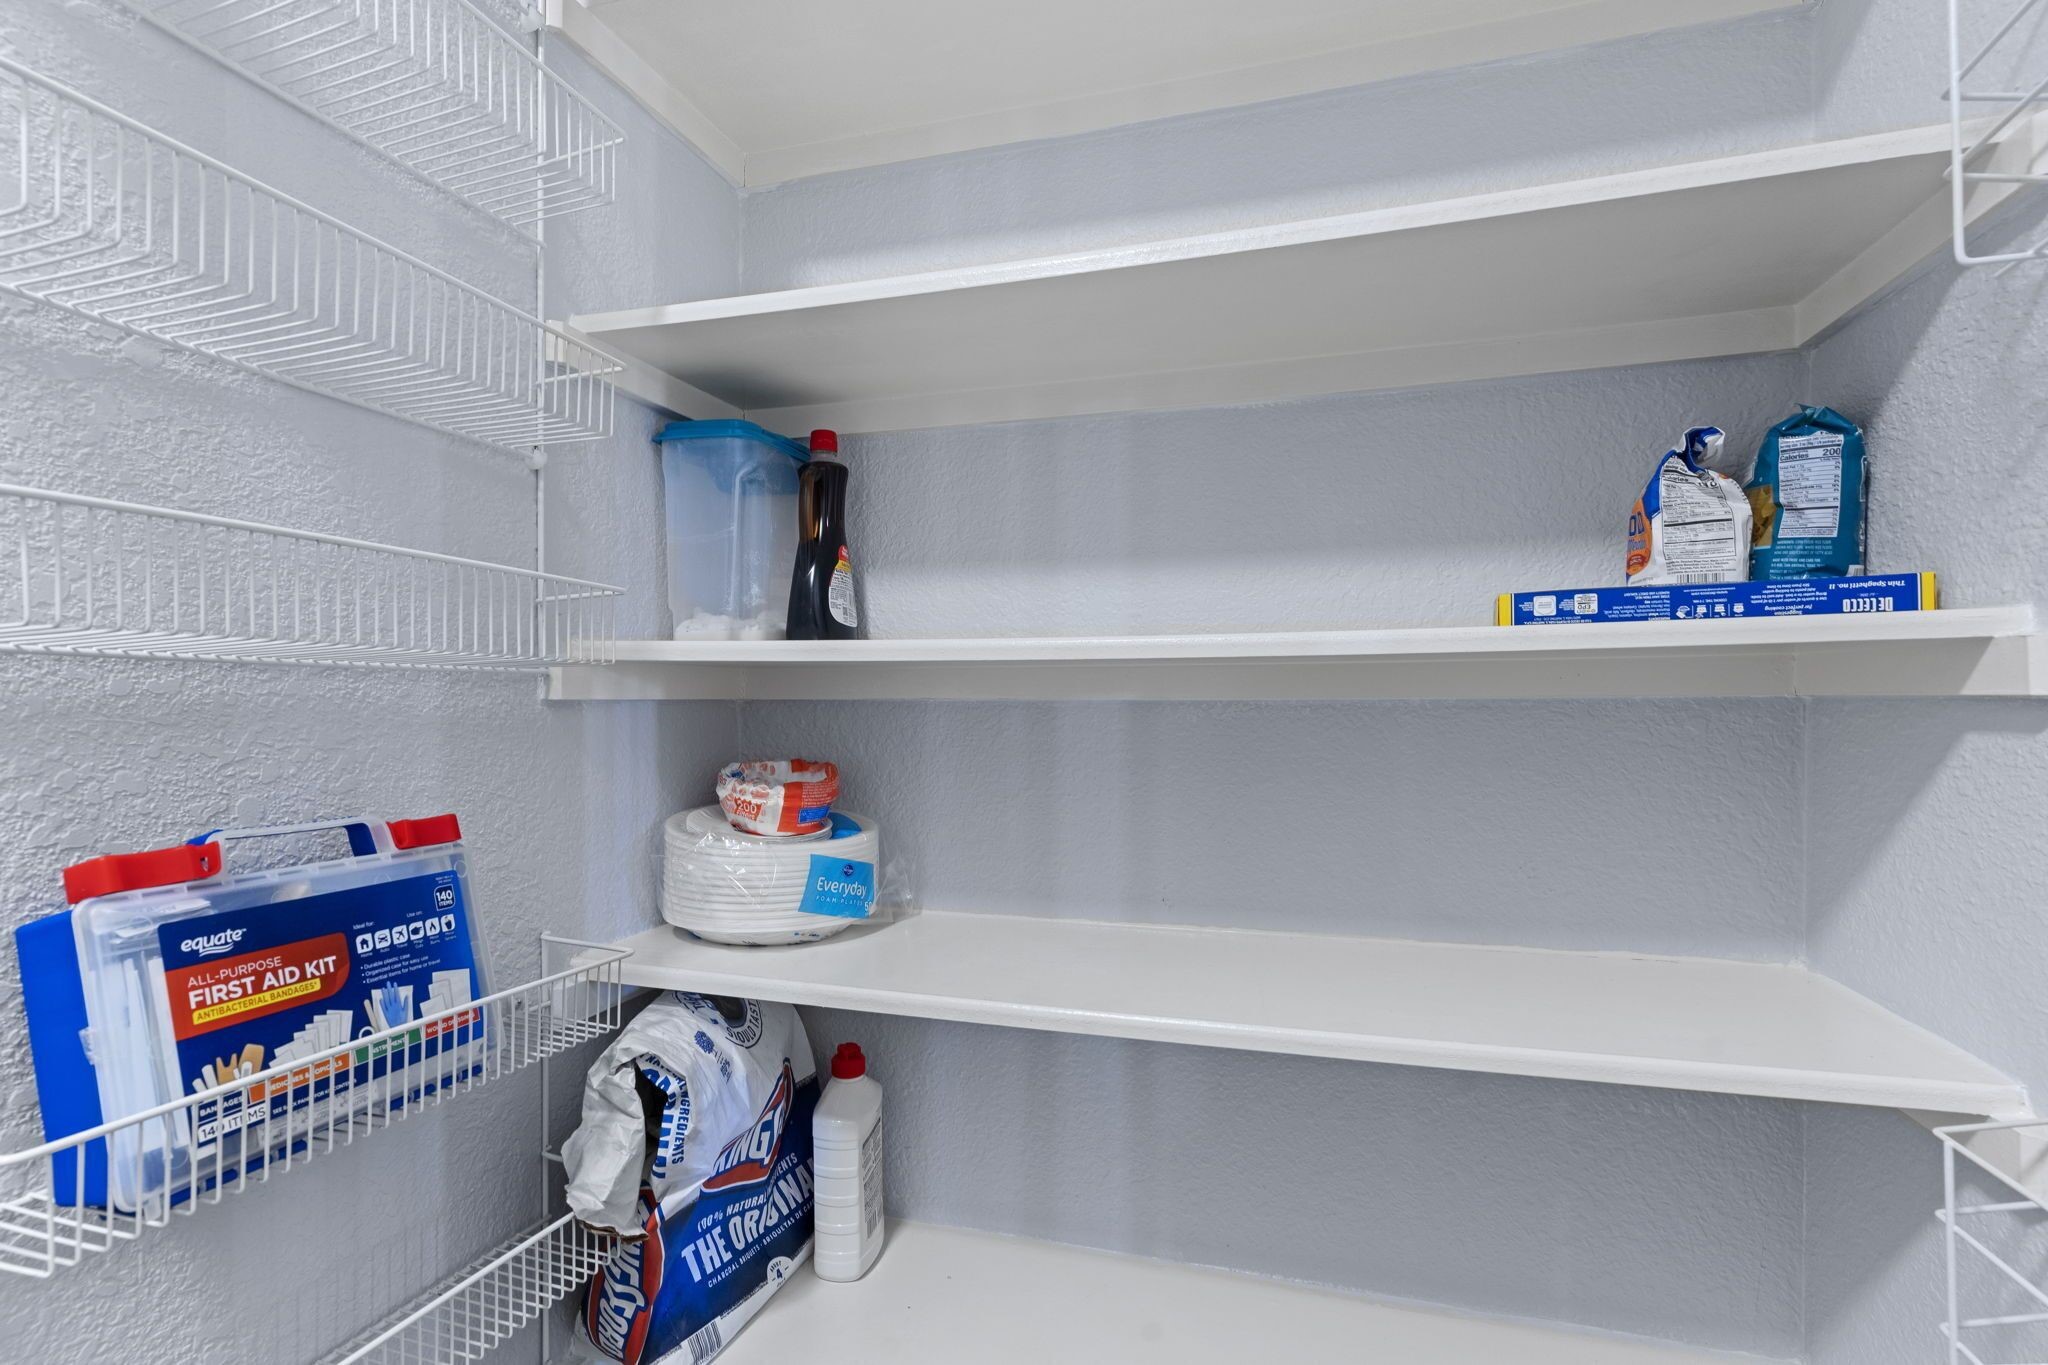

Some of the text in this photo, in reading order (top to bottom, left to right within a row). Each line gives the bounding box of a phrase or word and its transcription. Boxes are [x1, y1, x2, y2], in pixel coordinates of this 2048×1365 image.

[1823, 448, 1840, 456] 200
[1850, 580, 1887, 590] Spaghetti
[1842, 597, 1893, 612] DE CECCO
[737, 802, 757, 814] 200
[436, 890, 452, 902] 140
[817, 876, 867, 899] Everyday
[180, 929, 243, 953] equate
[364, 961, 383, 969] Durable
[384, 956, 399, 965] plastic
[365, 965, 390, 976] Organized
[187, 956, 282, 988] ALL-PURPOSE
[367, 972, 388, 983] Essential
[188, 956, 338, 1010] FIRST AID KIT
[196, 993, 269, 1022] ANTIBACTERIAL
[200, 1096, 242, 1116] BANAGES
[681, 1226, 732, 1284] THE
[728, 1158, 814, 1250] ORIGINA
[698, 1193, 768, 1232] 100% NATURAL
[708, 1262, 740, 1288] CHARCOAL
[740, 1244, 760, 1265] BRIQUETS
[763, 1218, 796, 1246] BRIQUETAS
[795, 1212, 804, 1220] DE
[776, 1268, 783, 1279] 4
